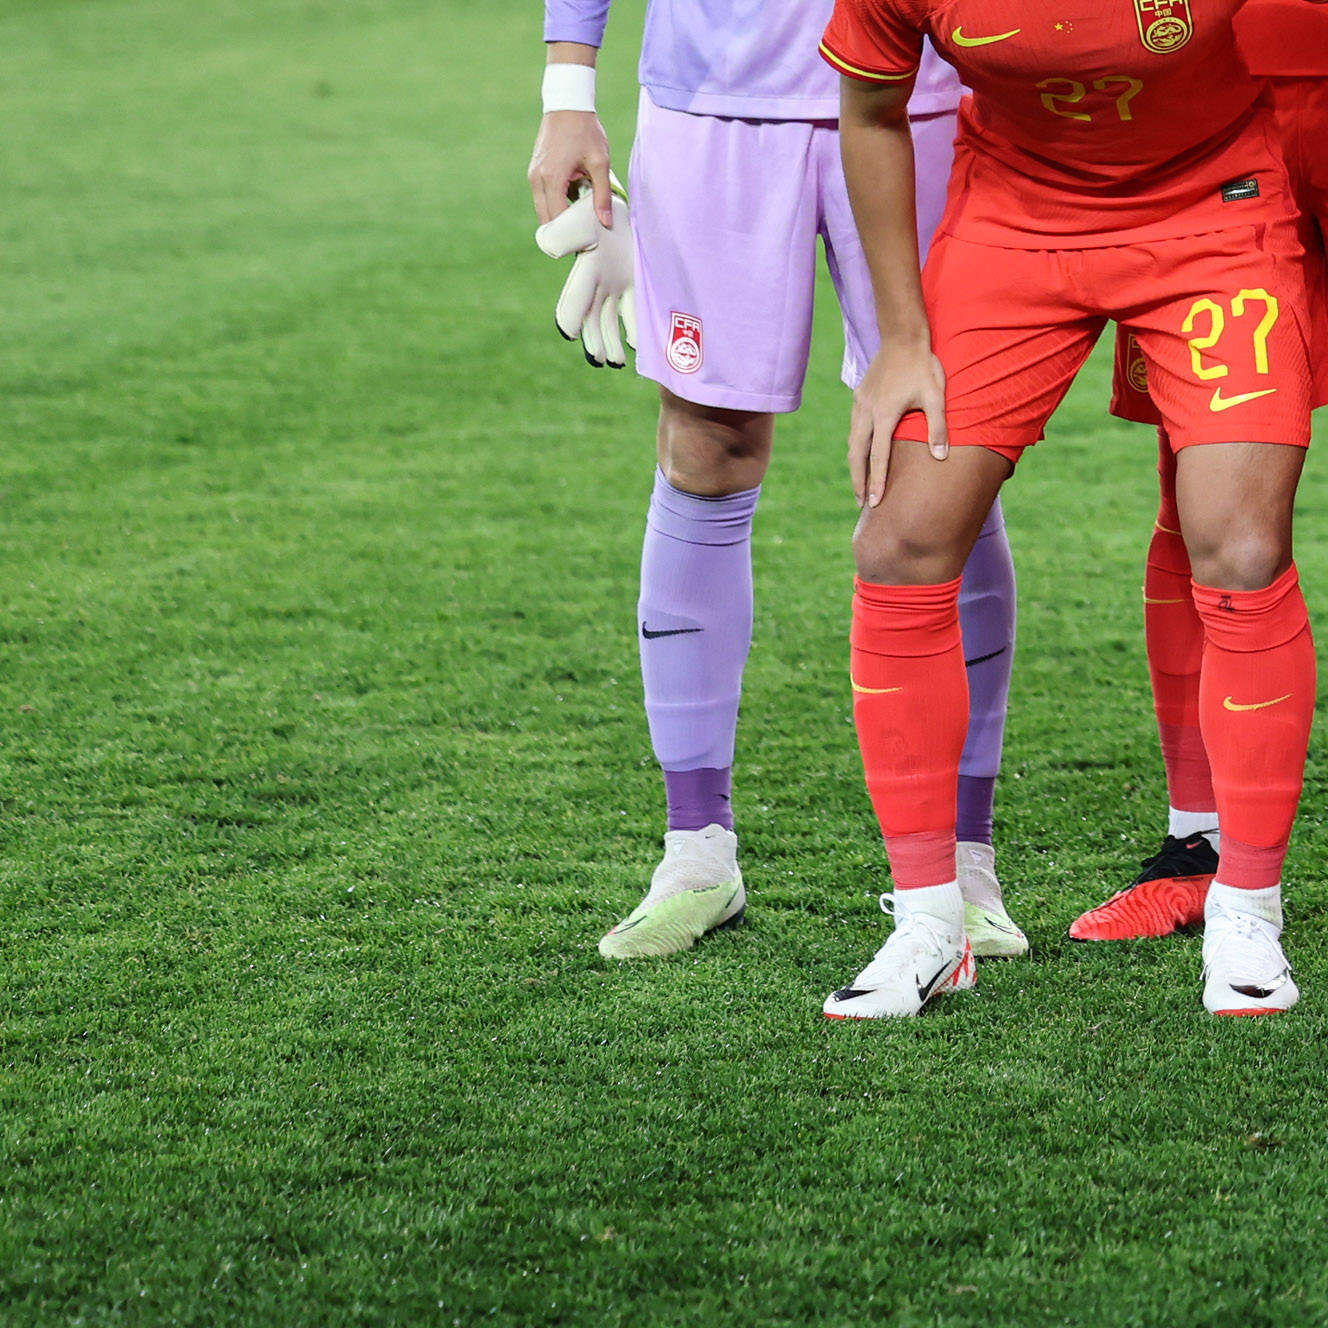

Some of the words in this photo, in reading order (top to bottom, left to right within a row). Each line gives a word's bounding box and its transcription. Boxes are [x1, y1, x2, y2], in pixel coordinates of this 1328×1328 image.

[1154, 8, 1172, 18] 中国
[1034, 75, 1144, 121] 27
[675, 316, 700, 332] CFA
[1181, 288, 1280, 381] 27
